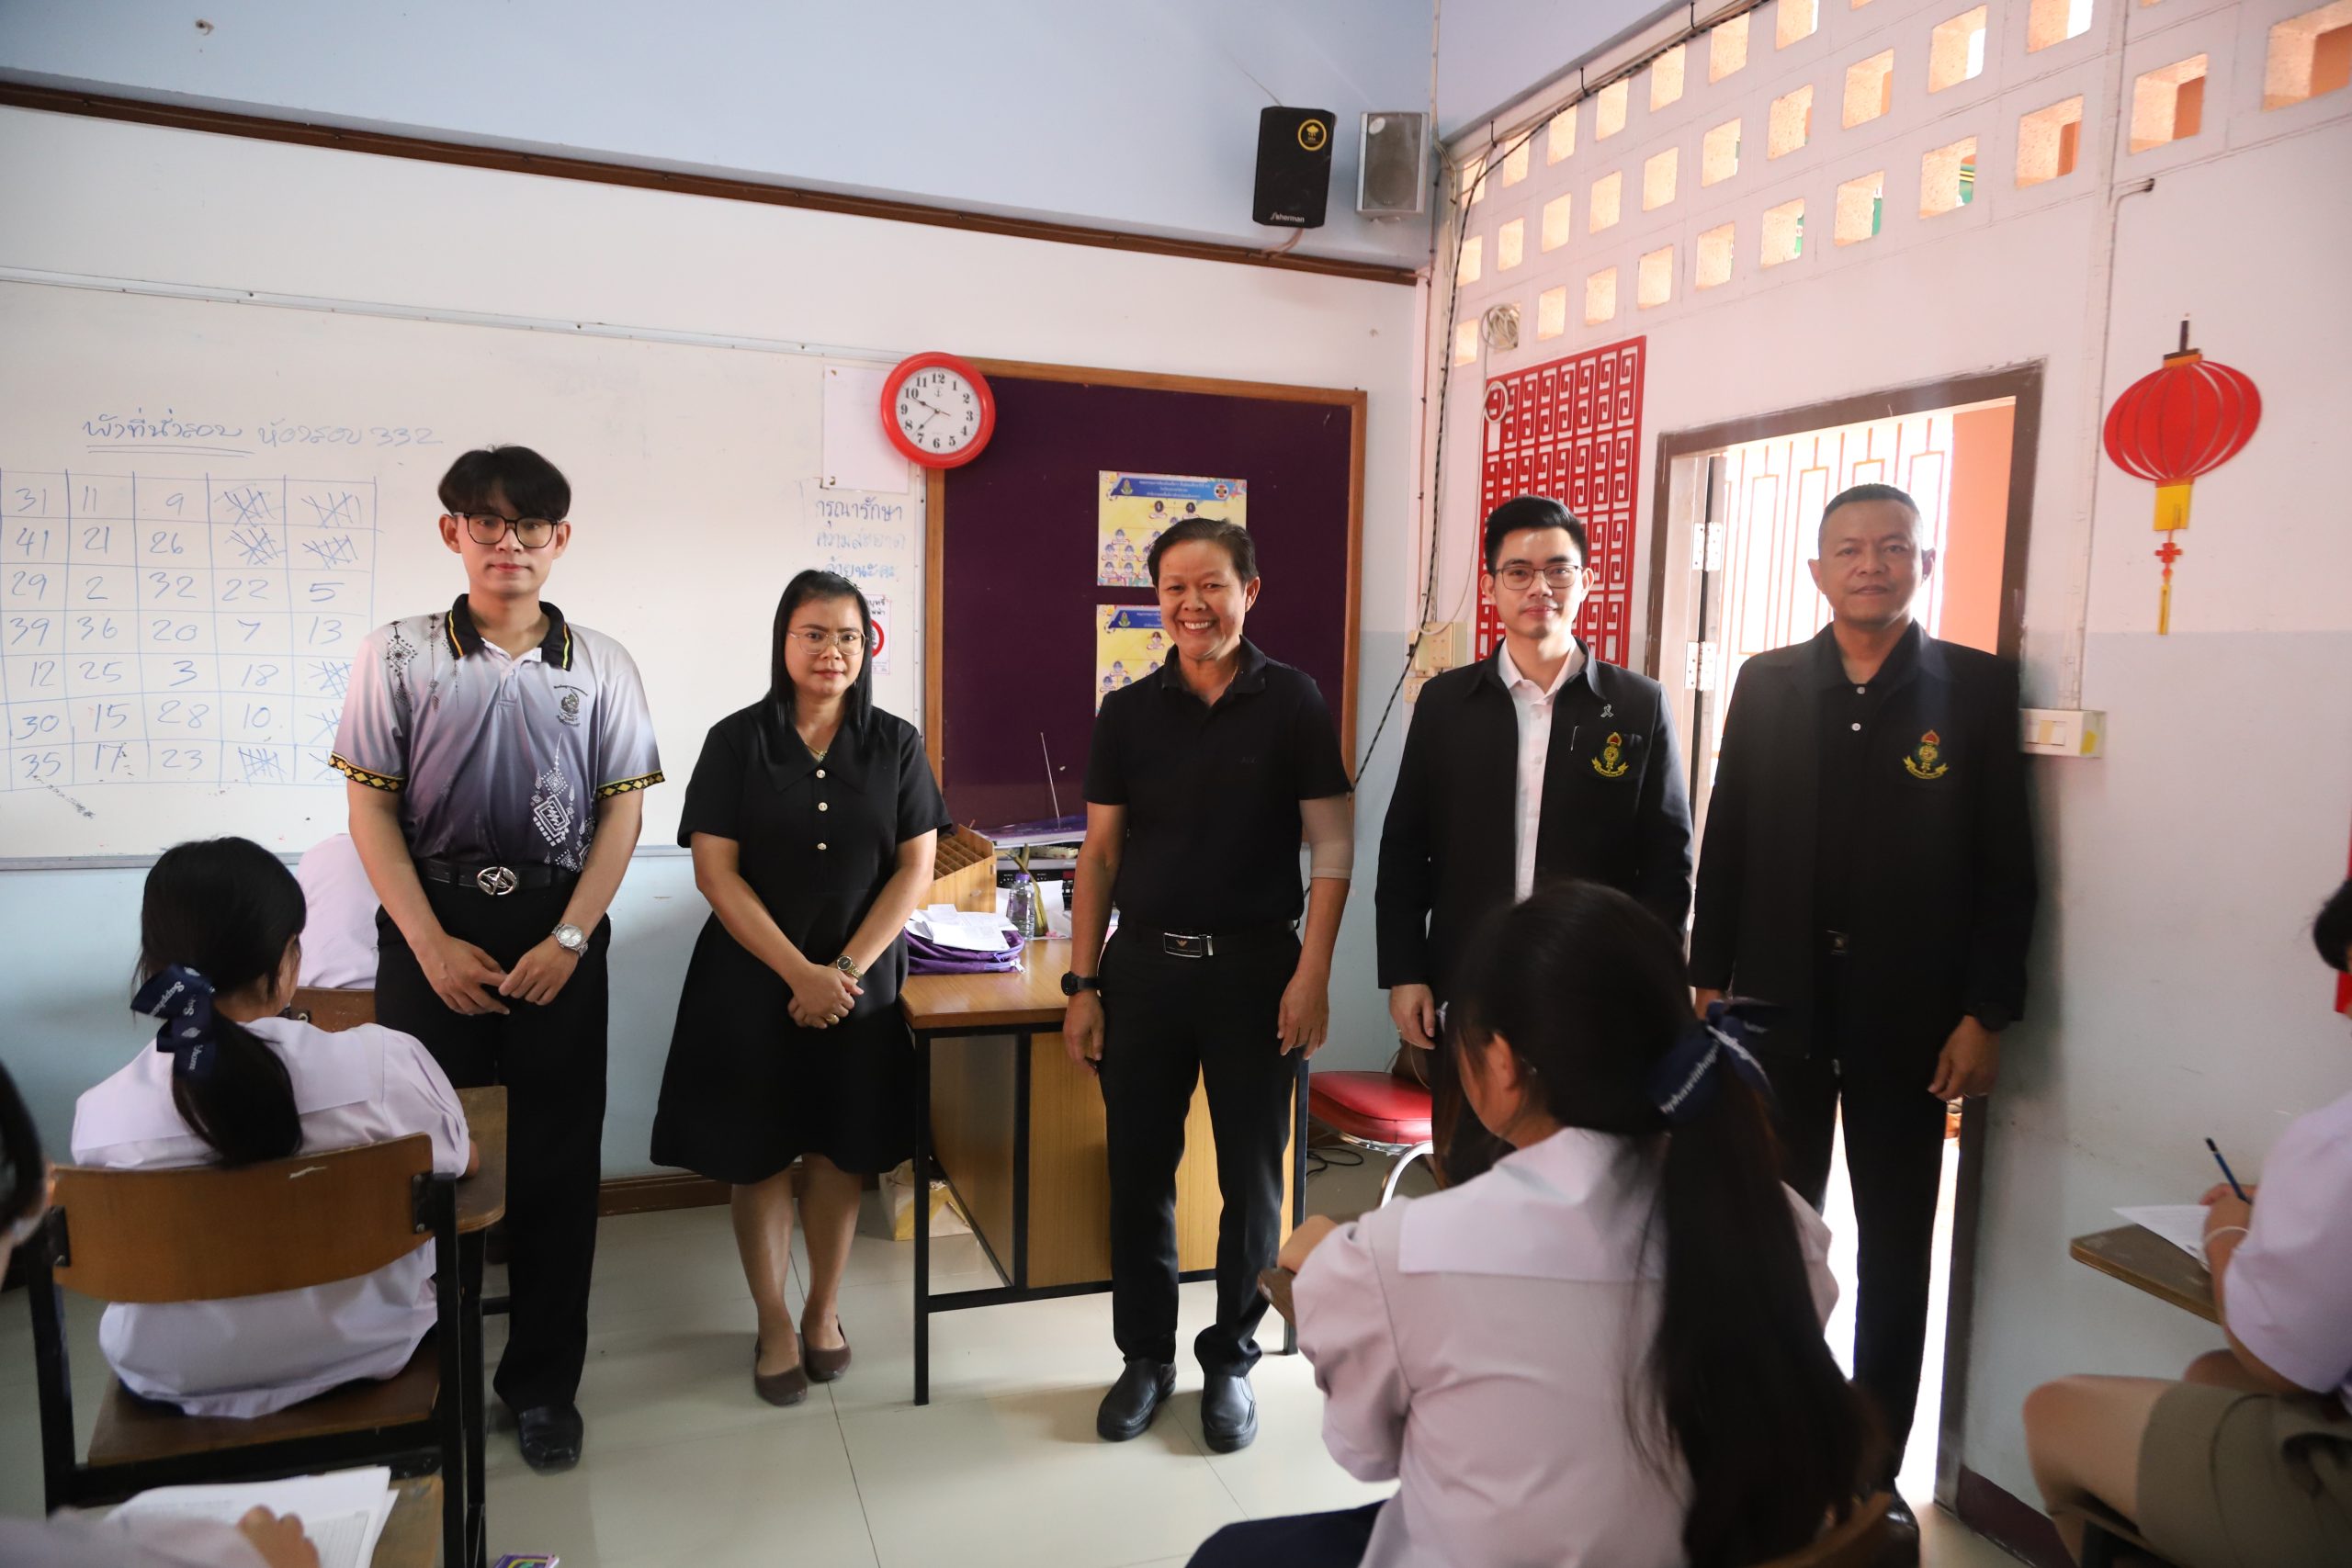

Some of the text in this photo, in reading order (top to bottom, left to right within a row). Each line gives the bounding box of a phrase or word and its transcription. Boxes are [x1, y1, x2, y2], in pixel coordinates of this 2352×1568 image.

[916, 376, 927, 388] 11
[932, 373, 945, 384] 12
[952, 380, 957, 391] 1
[905, 387, 919, 399] 10
[962, 392, 970, 404] 2
[900, 404, 909, 415] 9
[966, 411, 974, 422] 3
[904, 419, 913, 430] 8
[960, 425, 967, 436] 4
[370, 426, 444, 446] 332
[917, 433, 924, 444] 7
[948, 435, 956, 446] 5
[933, 438, 941, 449] 6
[16, 485, 184, 515] 31 11 9
[16, 525, 184, 559] 41 21 26
[11, 570, 345, 603] 29 2 32 22 5
[9, 617, 51, 646] 39
[77, 616, 118, 641] 36
[153, 619, 198, 642] 20
[308, 616, 343, 644] 13
[30, 660, 278, 687] 12 25 3 18
[16, 700, 271, 740] 30 15 28 10
[20, 742, 203, 779] 35 17 23
